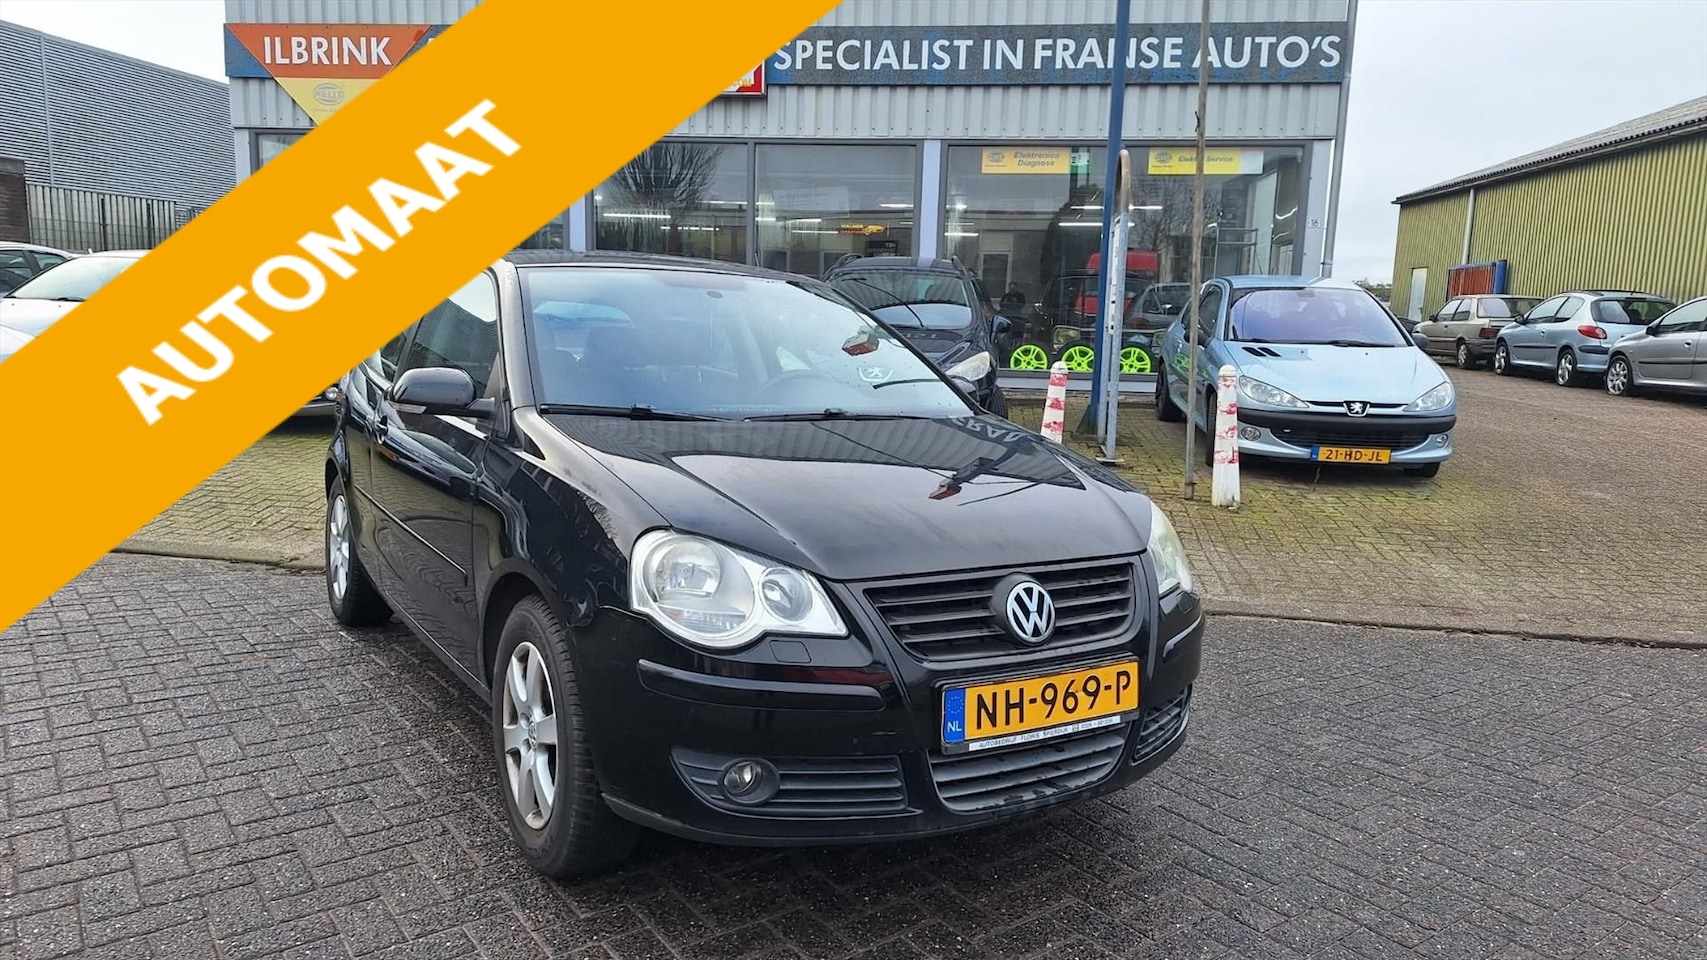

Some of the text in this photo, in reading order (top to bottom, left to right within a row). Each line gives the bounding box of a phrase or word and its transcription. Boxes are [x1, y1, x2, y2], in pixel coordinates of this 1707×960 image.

[263, 36, 392, 66] ILBRINK
[773, 35, 1341, 70] SPECIALIST IN FRANSE AUTO'S
[1325, 449, 1383, 462] 21-HD-JL
[976, 670, 1131, 730] NH-969-P
[947, 721, 963, 732] NL
